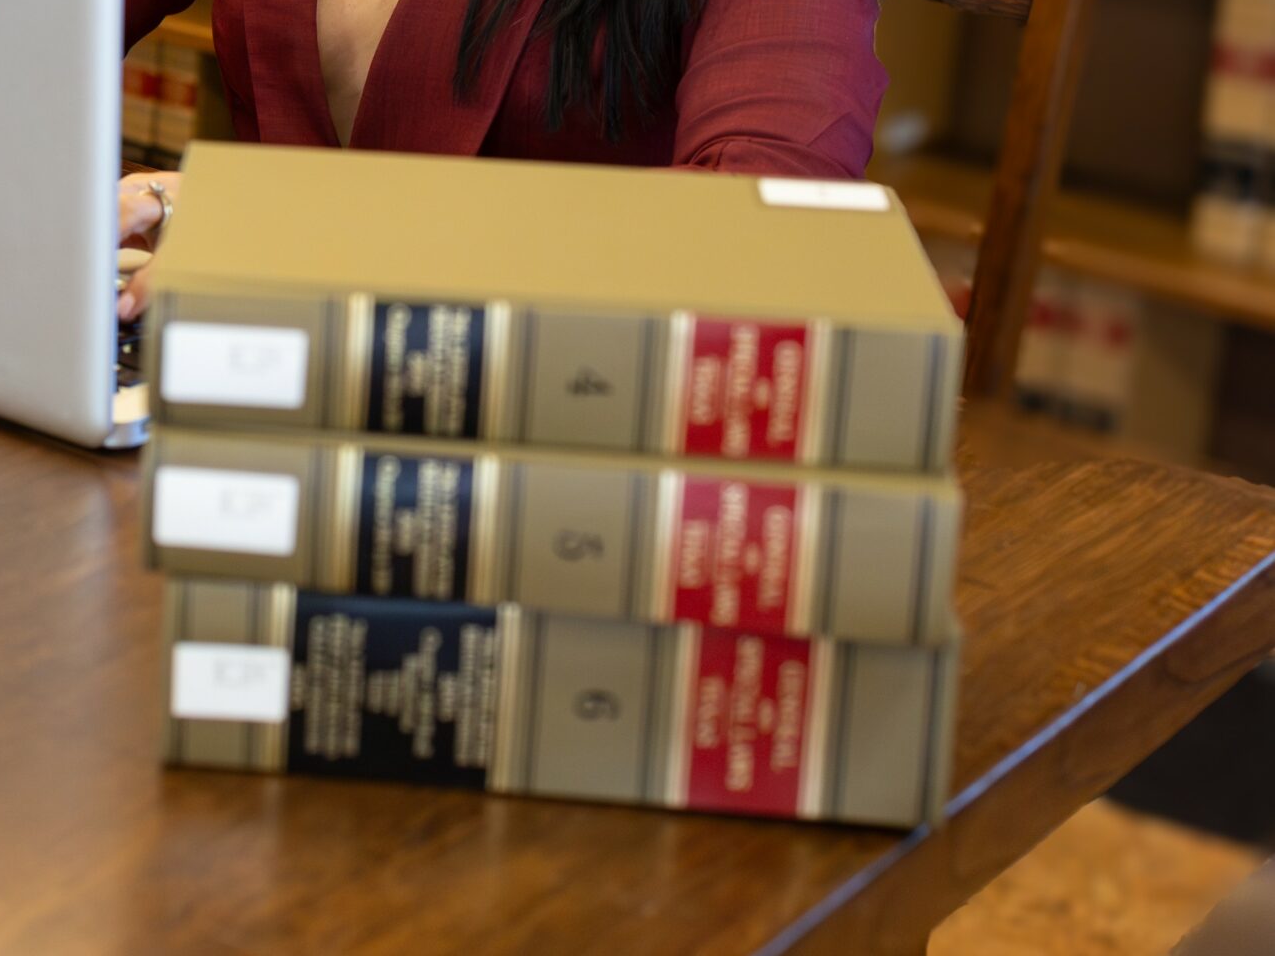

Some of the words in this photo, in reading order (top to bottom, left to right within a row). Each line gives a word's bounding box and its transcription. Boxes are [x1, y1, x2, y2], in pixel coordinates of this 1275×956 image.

[566, 365, 612, 397] 4
[554, 530, 603, 562] 5
[572, 689, 620, 723] 6
